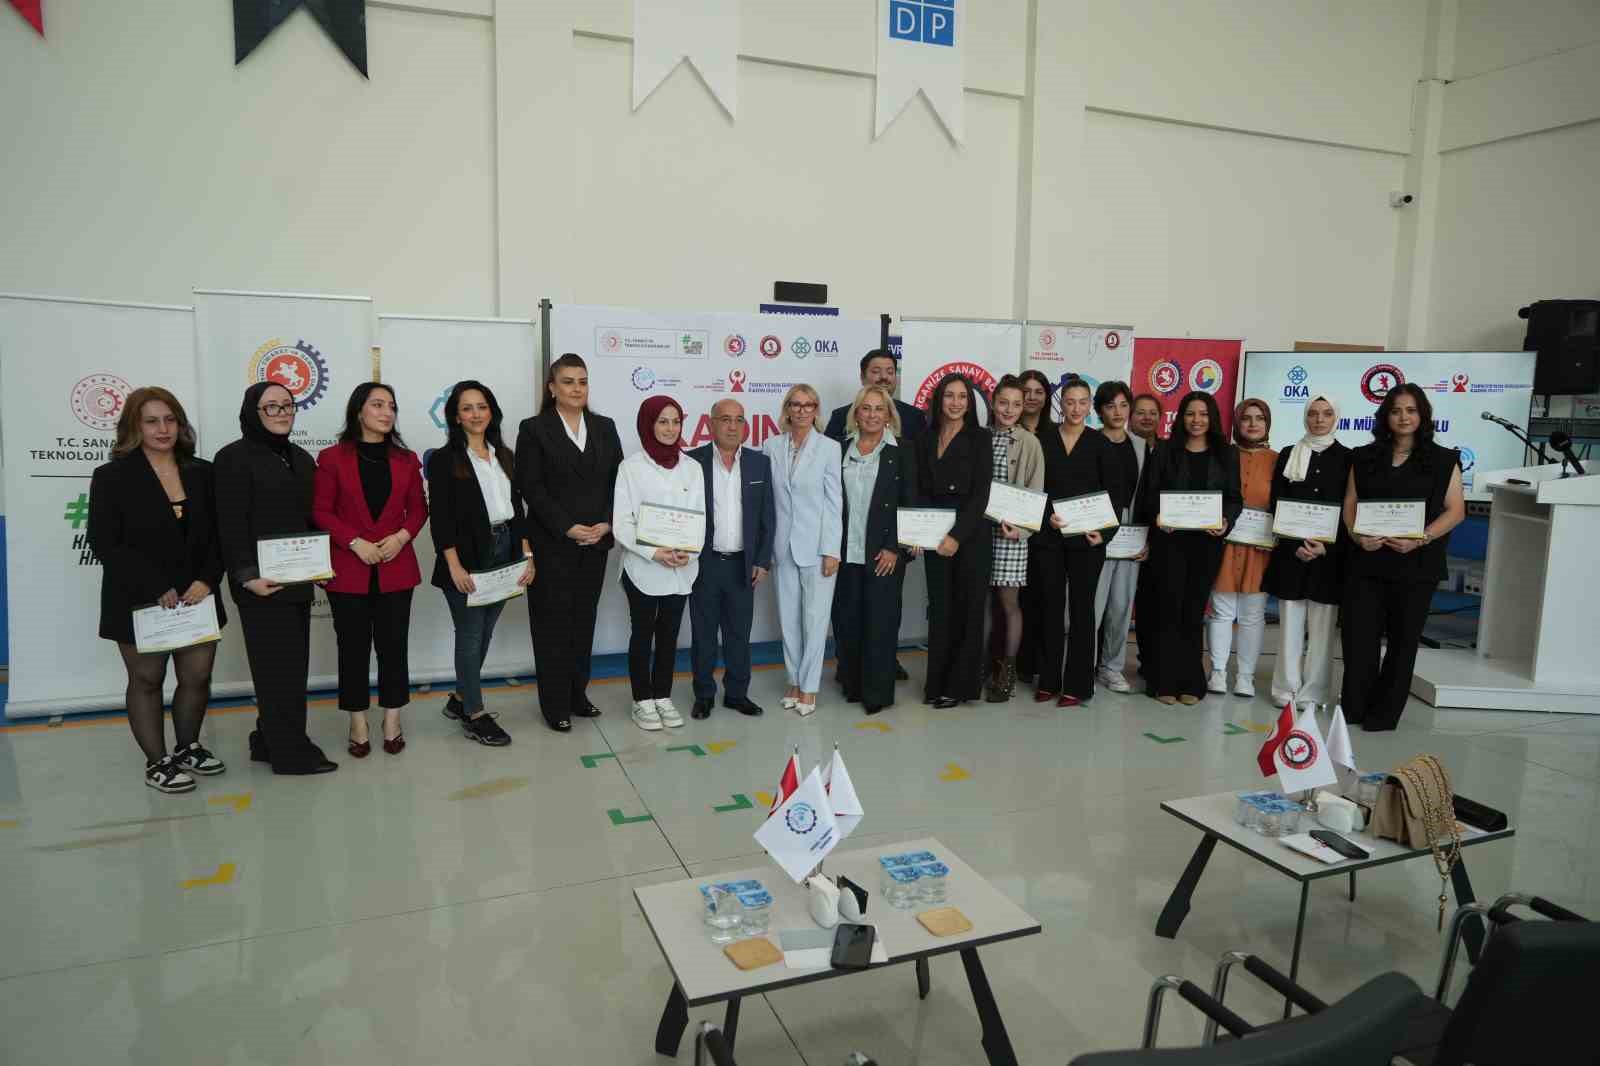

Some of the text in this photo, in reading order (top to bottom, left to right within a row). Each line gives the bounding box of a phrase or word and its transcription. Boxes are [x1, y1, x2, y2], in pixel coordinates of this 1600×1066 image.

[814, 340, 839, 353] OKA
[1284, 385, 1310, 398] OKA
[56, 438, 80, 448] T.C.
